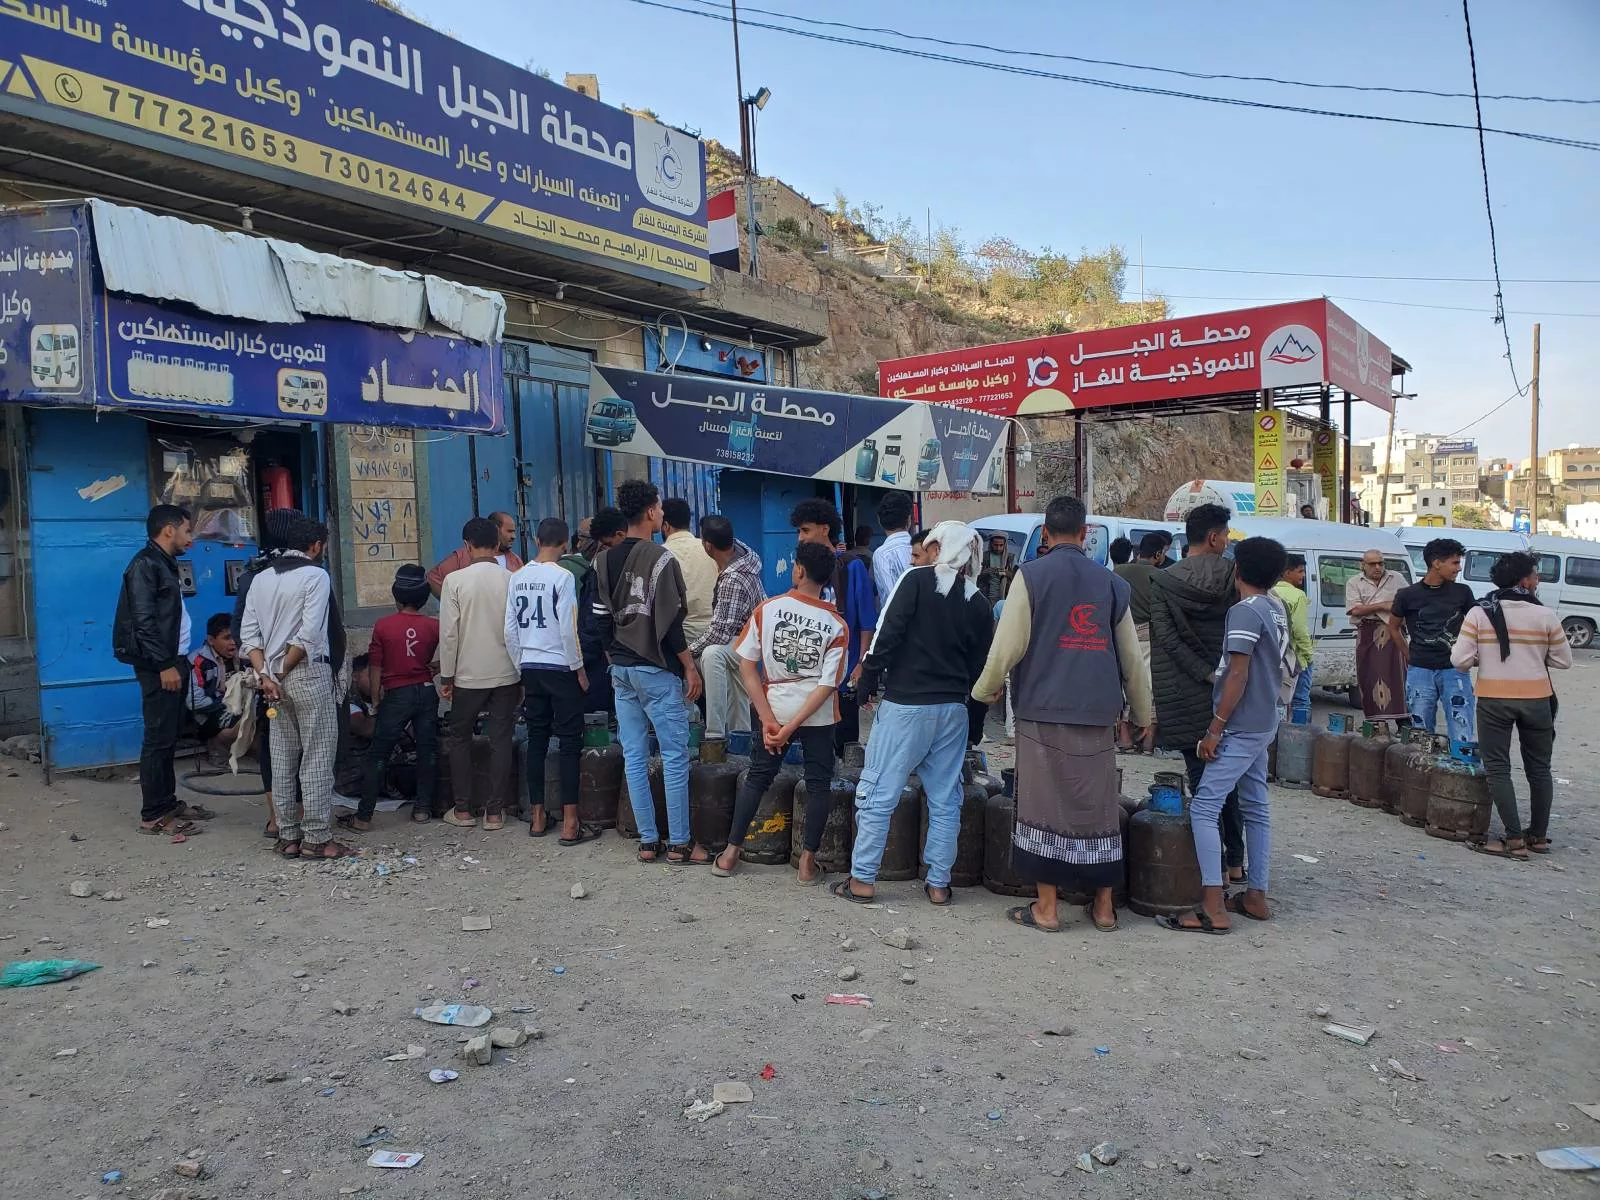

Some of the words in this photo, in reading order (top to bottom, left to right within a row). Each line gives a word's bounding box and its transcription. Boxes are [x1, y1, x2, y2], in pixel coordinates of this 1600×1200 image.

[0, 0, 101, 43] ساسك
[112, 22, 226, 84] مؤسسة
[236, 68, 300, 116] وكيل
[438, 65, 530, 135] الجبل
[325, 98, 450, 158] المستهلكين
[541, 102, 632, 170] محطة
[102, 85, 298, 163] 777221653
[320, 150, 466, 211] 730124644
[456, 143, 492, 173] كبار
[513, 163, 574, 198] السيارات
[513, 211, 555, 235] الجناد
[638, 213, 655, 226] للغاز
[657, 218, 680, 236] اليمنية
[683, 227, 707, 242] الشركة
[560, 226, 600, 246] محمد
[0, 247, 21, 277] الجن
[24, 246, 73, 275] مجموعة
[0, 289, 31, 324] وكيل
[118, 317, 235, 350] المستهلكين
[236, 334, 267, 359] كبار
[1070, 332, 1165, 365] الجبل
[1169, 323, 1251, 349] محطة
[269, 342, 326, 365] لتموين
[951, 360, 982, 373] السيارات
[1130, 351, 1255, 383] النموذجية
[361, 357, 480, 421] الجناد
[893, 382, 936, 398] ساسكو
[939, 378, 979, 392] مؤسسة
[982, 373, 1009, 388] وكيل
[1072, 366, 1124, 392] للغاز
[651, 383, 745, 415] الجبل
[751, 392, 836, 426] محطة
[699, 421, 733, 434] المسال
[516, 595, 547, 628] 24
[774, 607, 833, 633] AQWEAR
